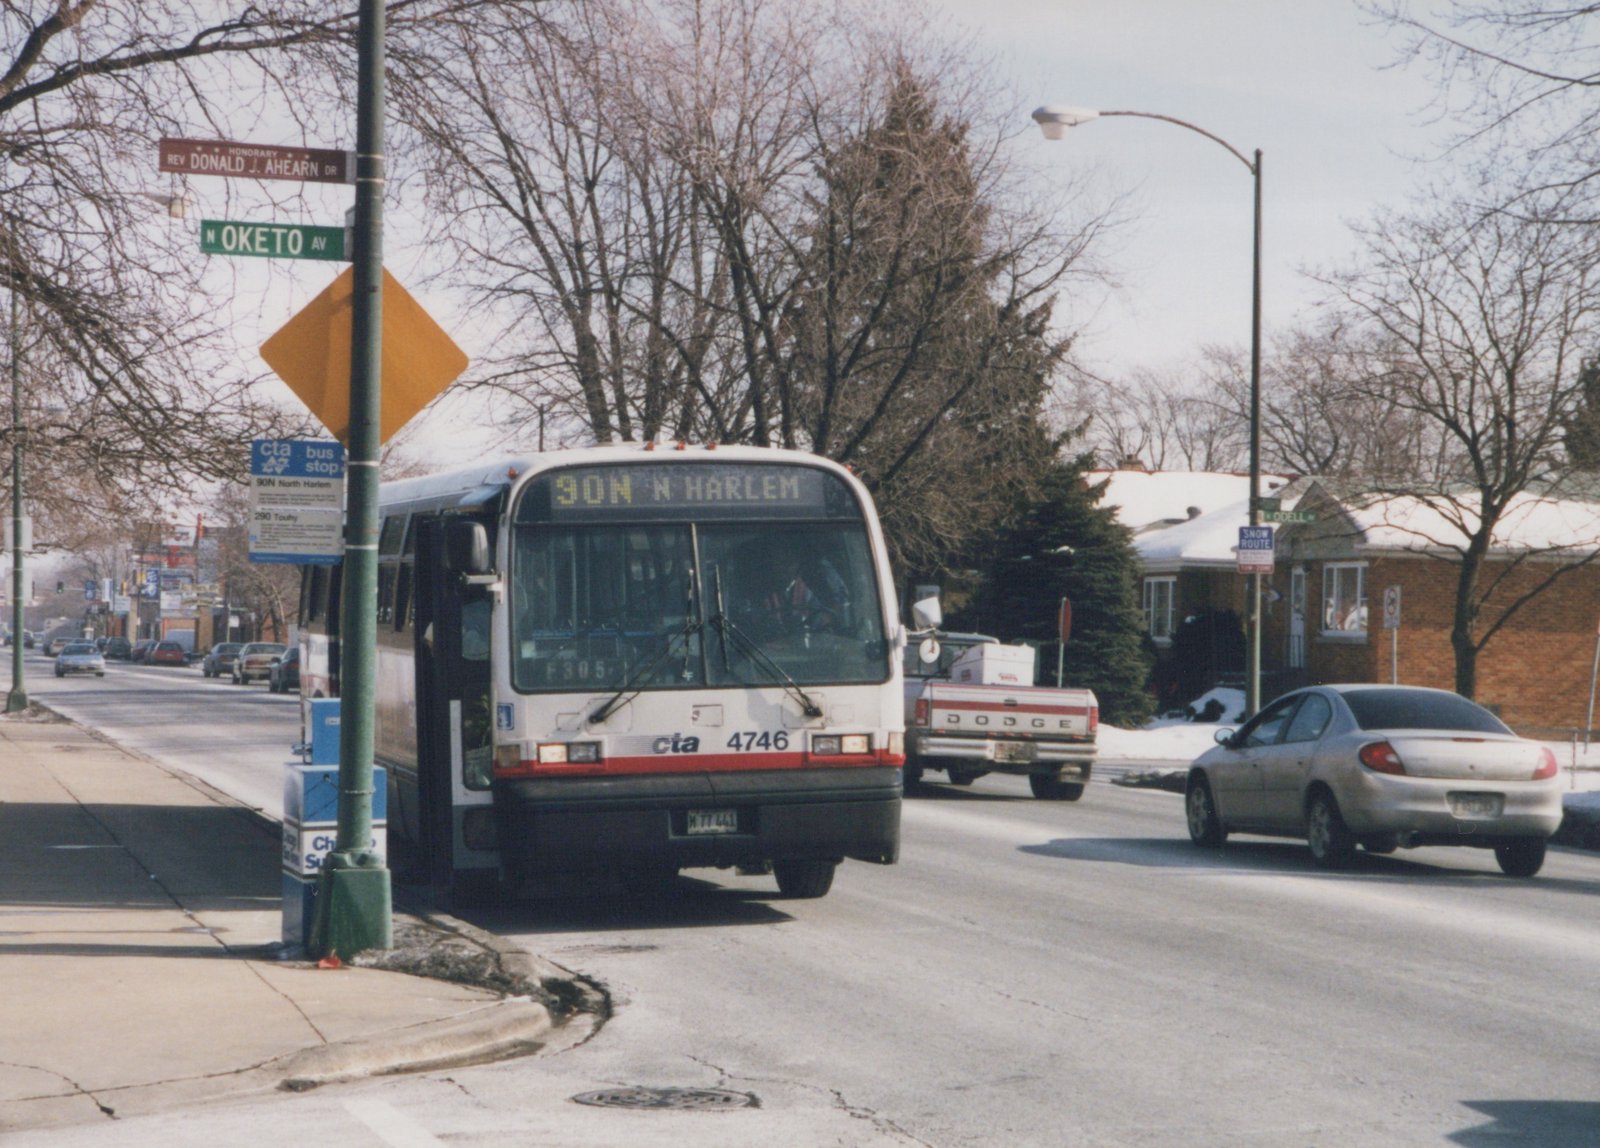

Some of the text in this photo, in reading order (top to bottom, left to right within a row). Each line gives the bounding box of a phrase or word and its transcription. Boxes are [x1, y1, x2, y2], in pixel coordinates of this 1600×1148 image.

[229, 147, 278, 158] HONORARY
[167, 153, 337, 177] REV DONALD J. AHEARN DR
[206, 224, 327, 255] N OKETO AV
[260, 442, 291, 457] cta
[306, 446, 334, 459] bus
[305, 461, 339, 475] stop
[257, 478, 332, 489] 90N North Harlem
[555, 474, 800, 505] 90N N HARLEM
[254, 512, 298, 523] 290 Touhy
[1273, 512, 1306, 522] ODELL
[1243, 529, 1269, 539] SNOW
[1241, 539, 1271, 549] ROUTE
[946, 713, 1072, 729] DODGE
[651, 730, 790, 754] cta 4746
